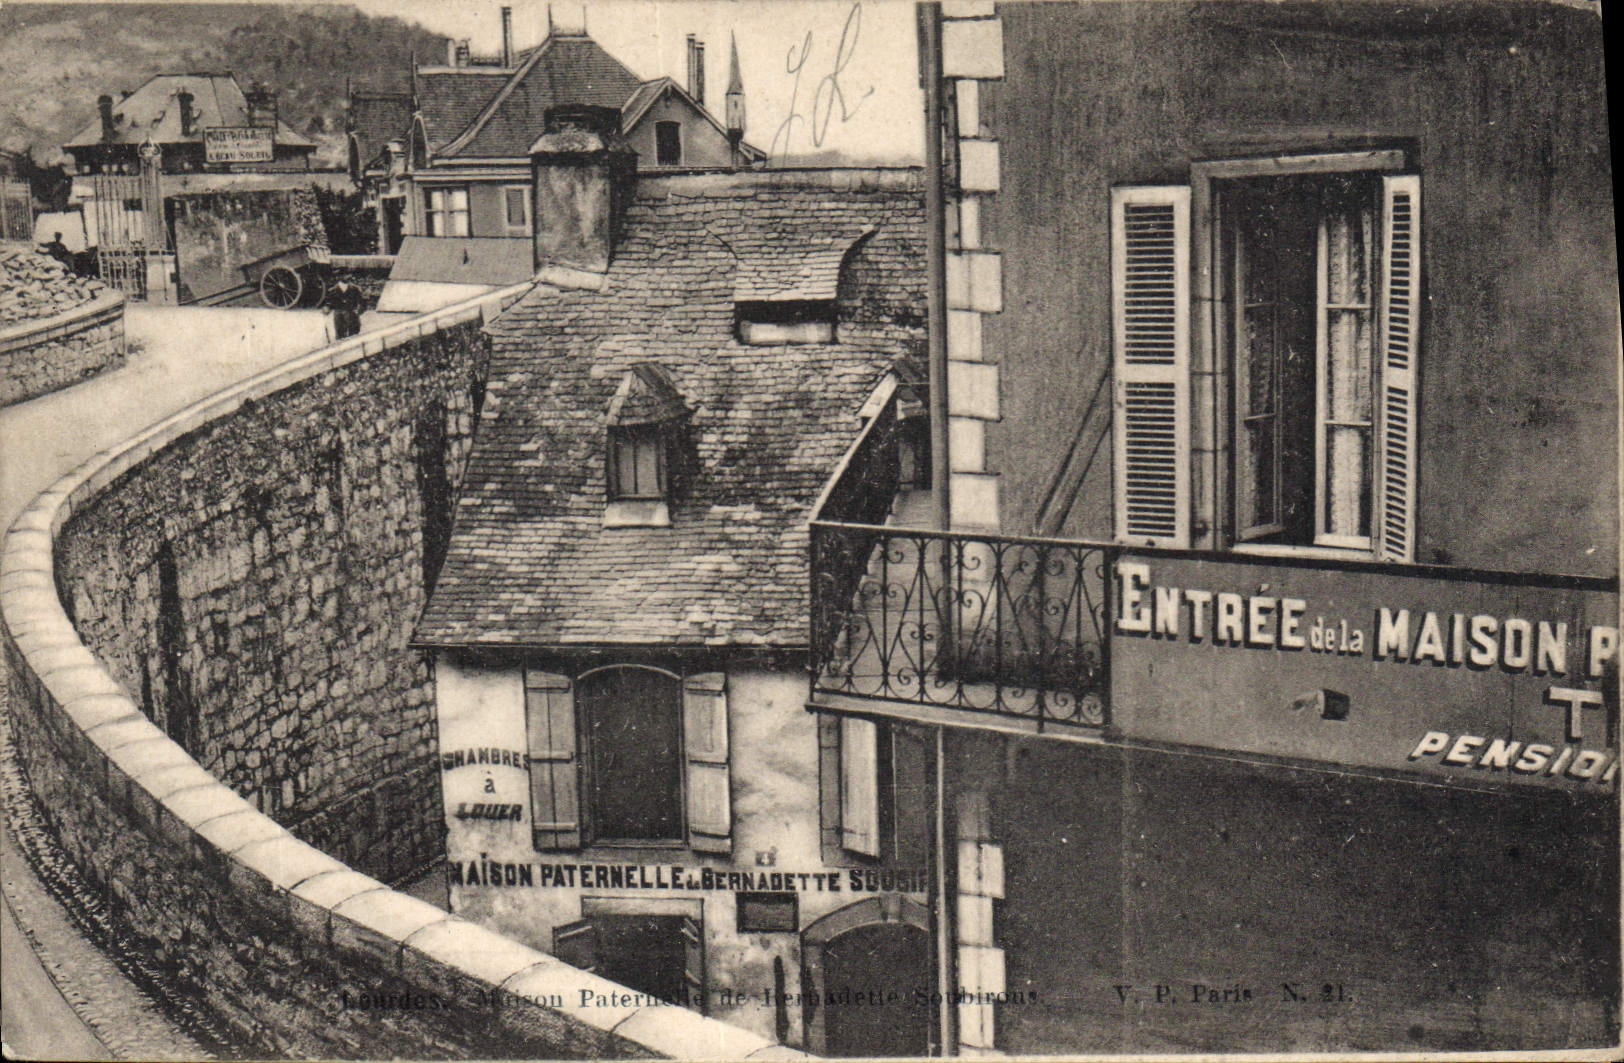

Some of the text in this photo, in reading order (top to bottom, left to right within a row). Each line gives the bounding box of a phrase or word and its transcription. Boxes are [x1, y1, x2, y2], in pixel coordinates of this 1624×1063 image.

[1115, 561, 1307, 650] ENTRÉE
[1310, 616, 1335, 653] de
[1338, 618, 1365, 656] la
[1374, 607, 1568, 676] MAISON
[541, 863, 684, 889] PATERNELLE
[701, 867, 840, 892] BERNADETTE
